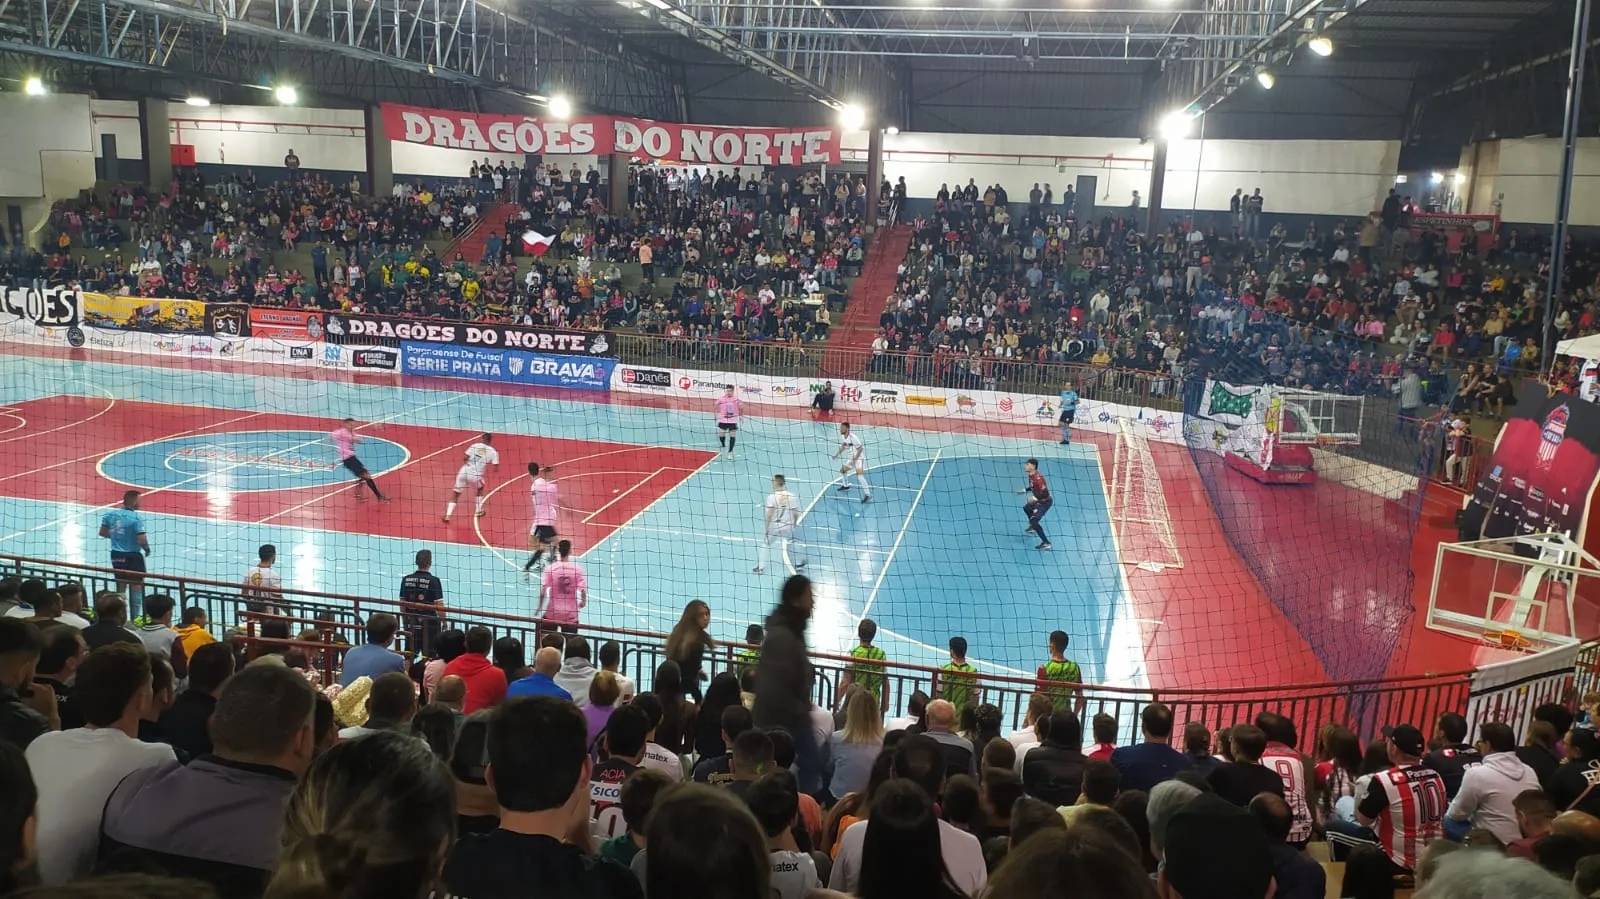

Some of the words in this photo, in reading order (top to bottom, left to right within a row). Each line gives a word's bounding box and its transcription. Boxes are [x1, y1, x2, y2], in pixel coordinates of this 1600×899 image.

[402, 111, 594, 154] DRAGÕES
[614, 120, 671, 157] DO
[680, 129, 832, 165] NORTE
[349, 319, 456, 342] DRAGÕES
[466, 327, 498, 345] DO
[504, 330, 586, 351] NORTE
[461, 350, 474, 359] De
[452, 359, 502, 377] PRATA
[530, 360, 595, 379] BRAVA
[600, 769, 626, 779] ACIA
[1275, 760, 1295, 792] 9
[1412, 782, 1441, 825] 10
